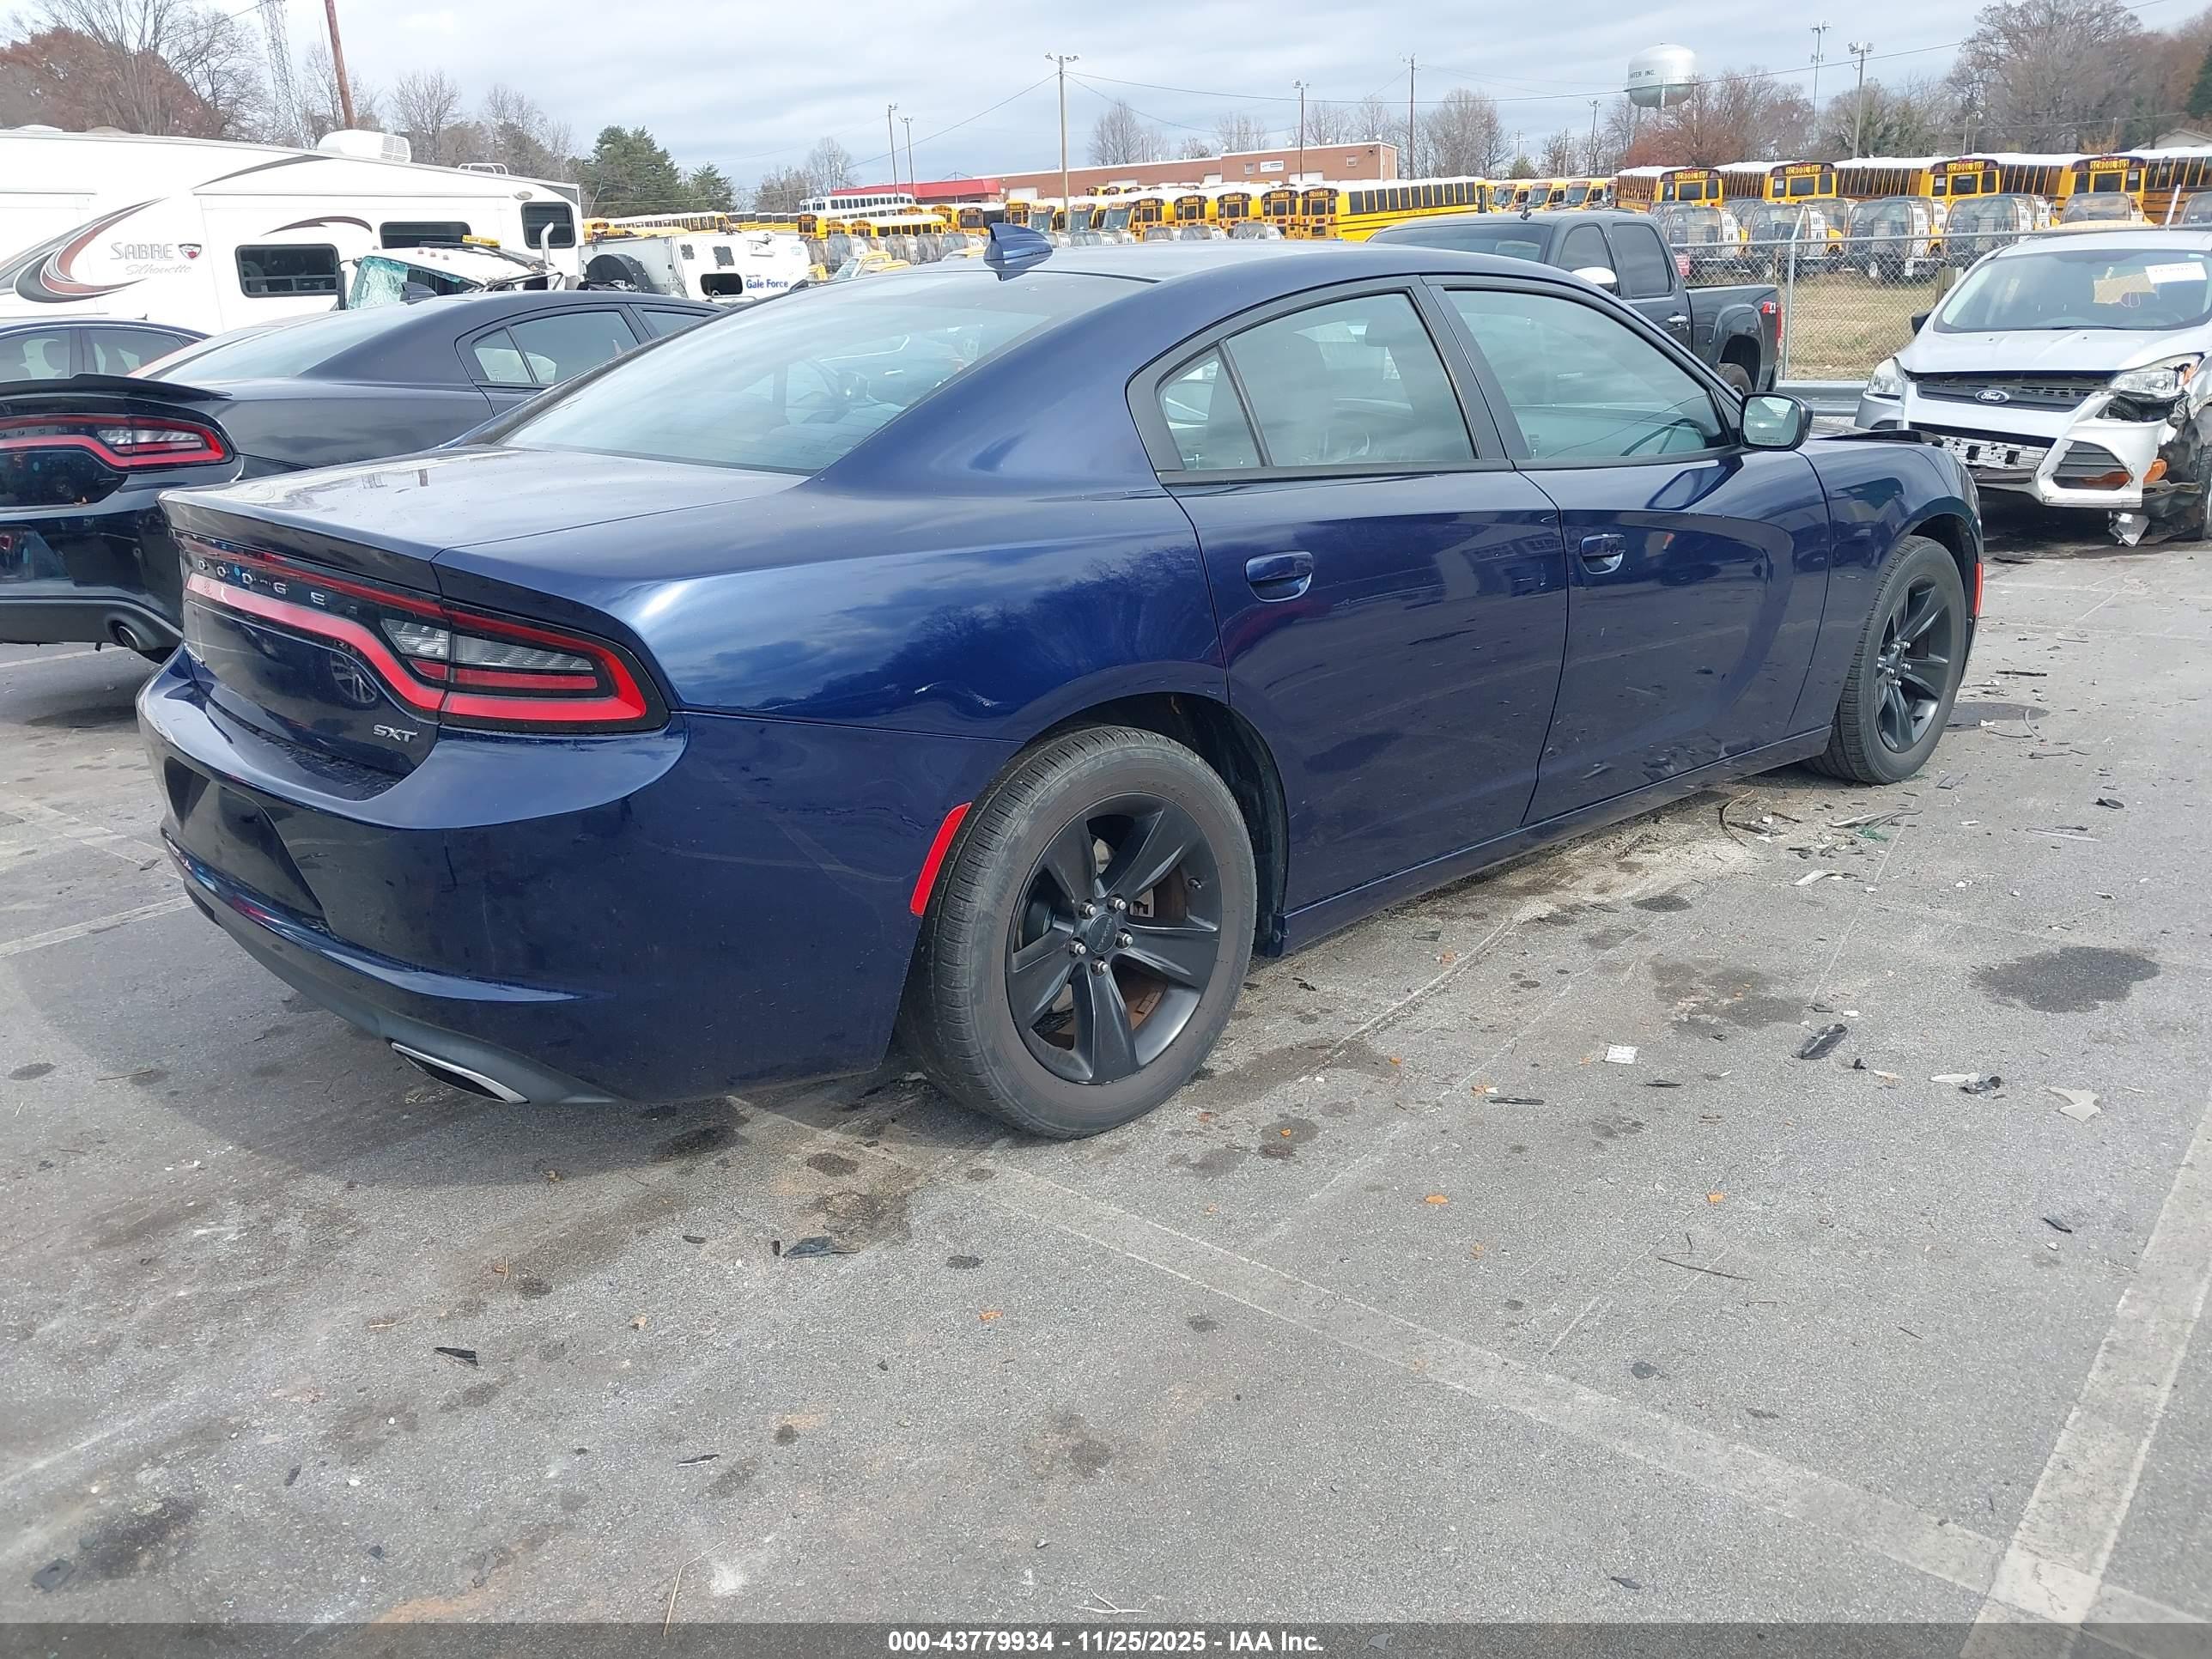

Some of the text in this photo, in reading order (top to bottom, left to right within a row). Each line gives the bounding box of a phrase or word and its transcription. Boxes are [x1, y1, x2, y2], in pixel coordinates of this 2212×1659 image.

[1786, 165, 1809, 175] SCHOOL
[1948, 162, 1972, 173] SCHOOL
[2090, 161, 2116, 171] SCHOOL
[1675, 172, 1698, 180] SCHOOL
[110, 242, 173, 259] SABRE
[125, 264, 191, 276] Silhouette
[746, 278, 789, 289] Gale Force
[198, 559, 326, 606] DODGE
[373, 724, 419, 743] SXT
